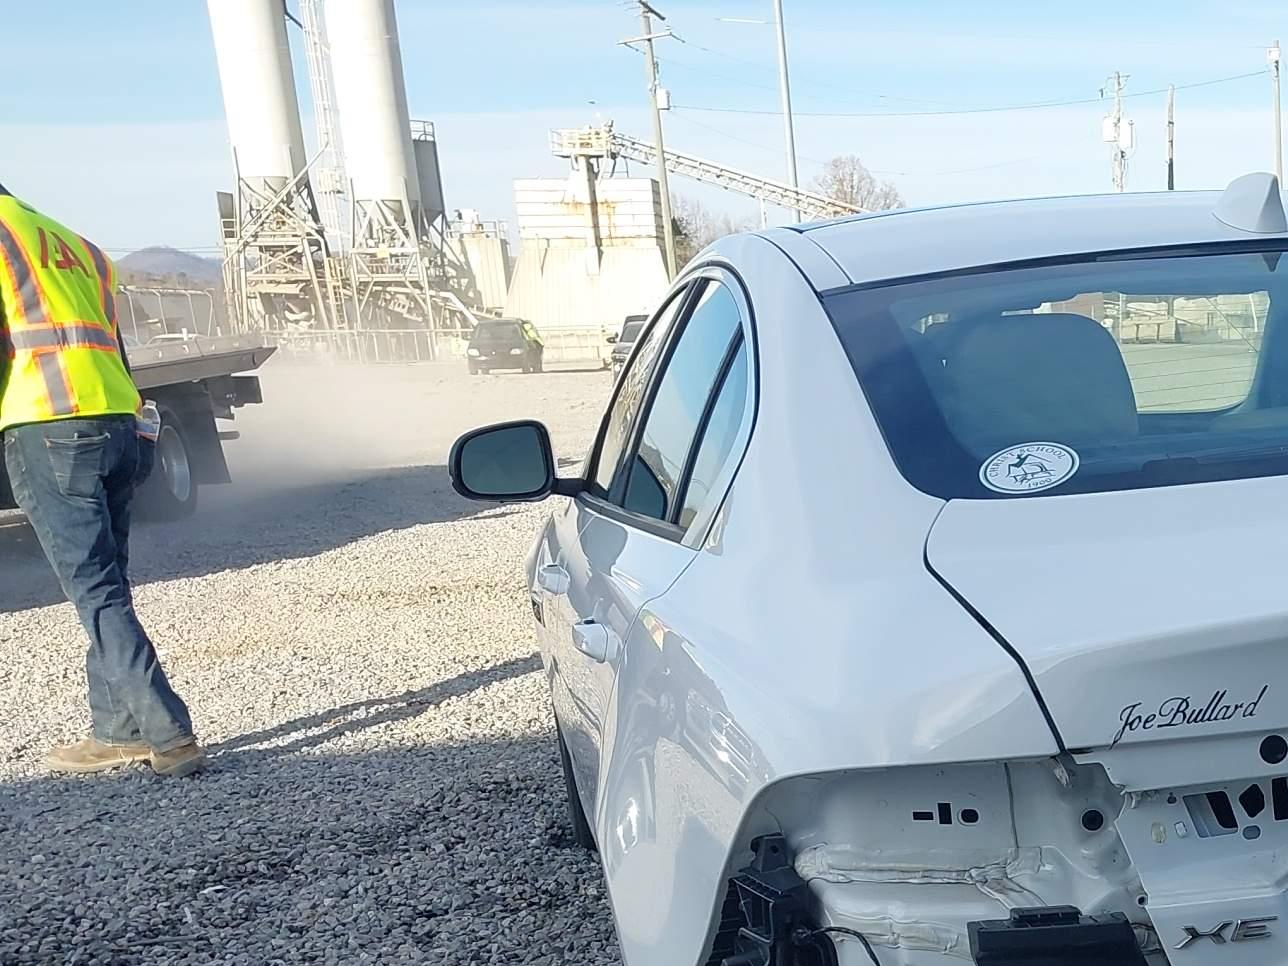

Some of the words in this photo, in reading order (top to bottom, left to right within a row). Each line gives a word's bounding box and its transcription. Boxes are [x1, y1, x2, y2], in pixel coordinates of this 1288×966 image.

[1019, 446, 1067, 460] SCHOOL
[1027, 478, 1053, 488] 1900
[1109, 701, 1157, 751] Joe
[1157, 684, 1269, 728] Bullard
[1172, 915, 1279, 950] XE
